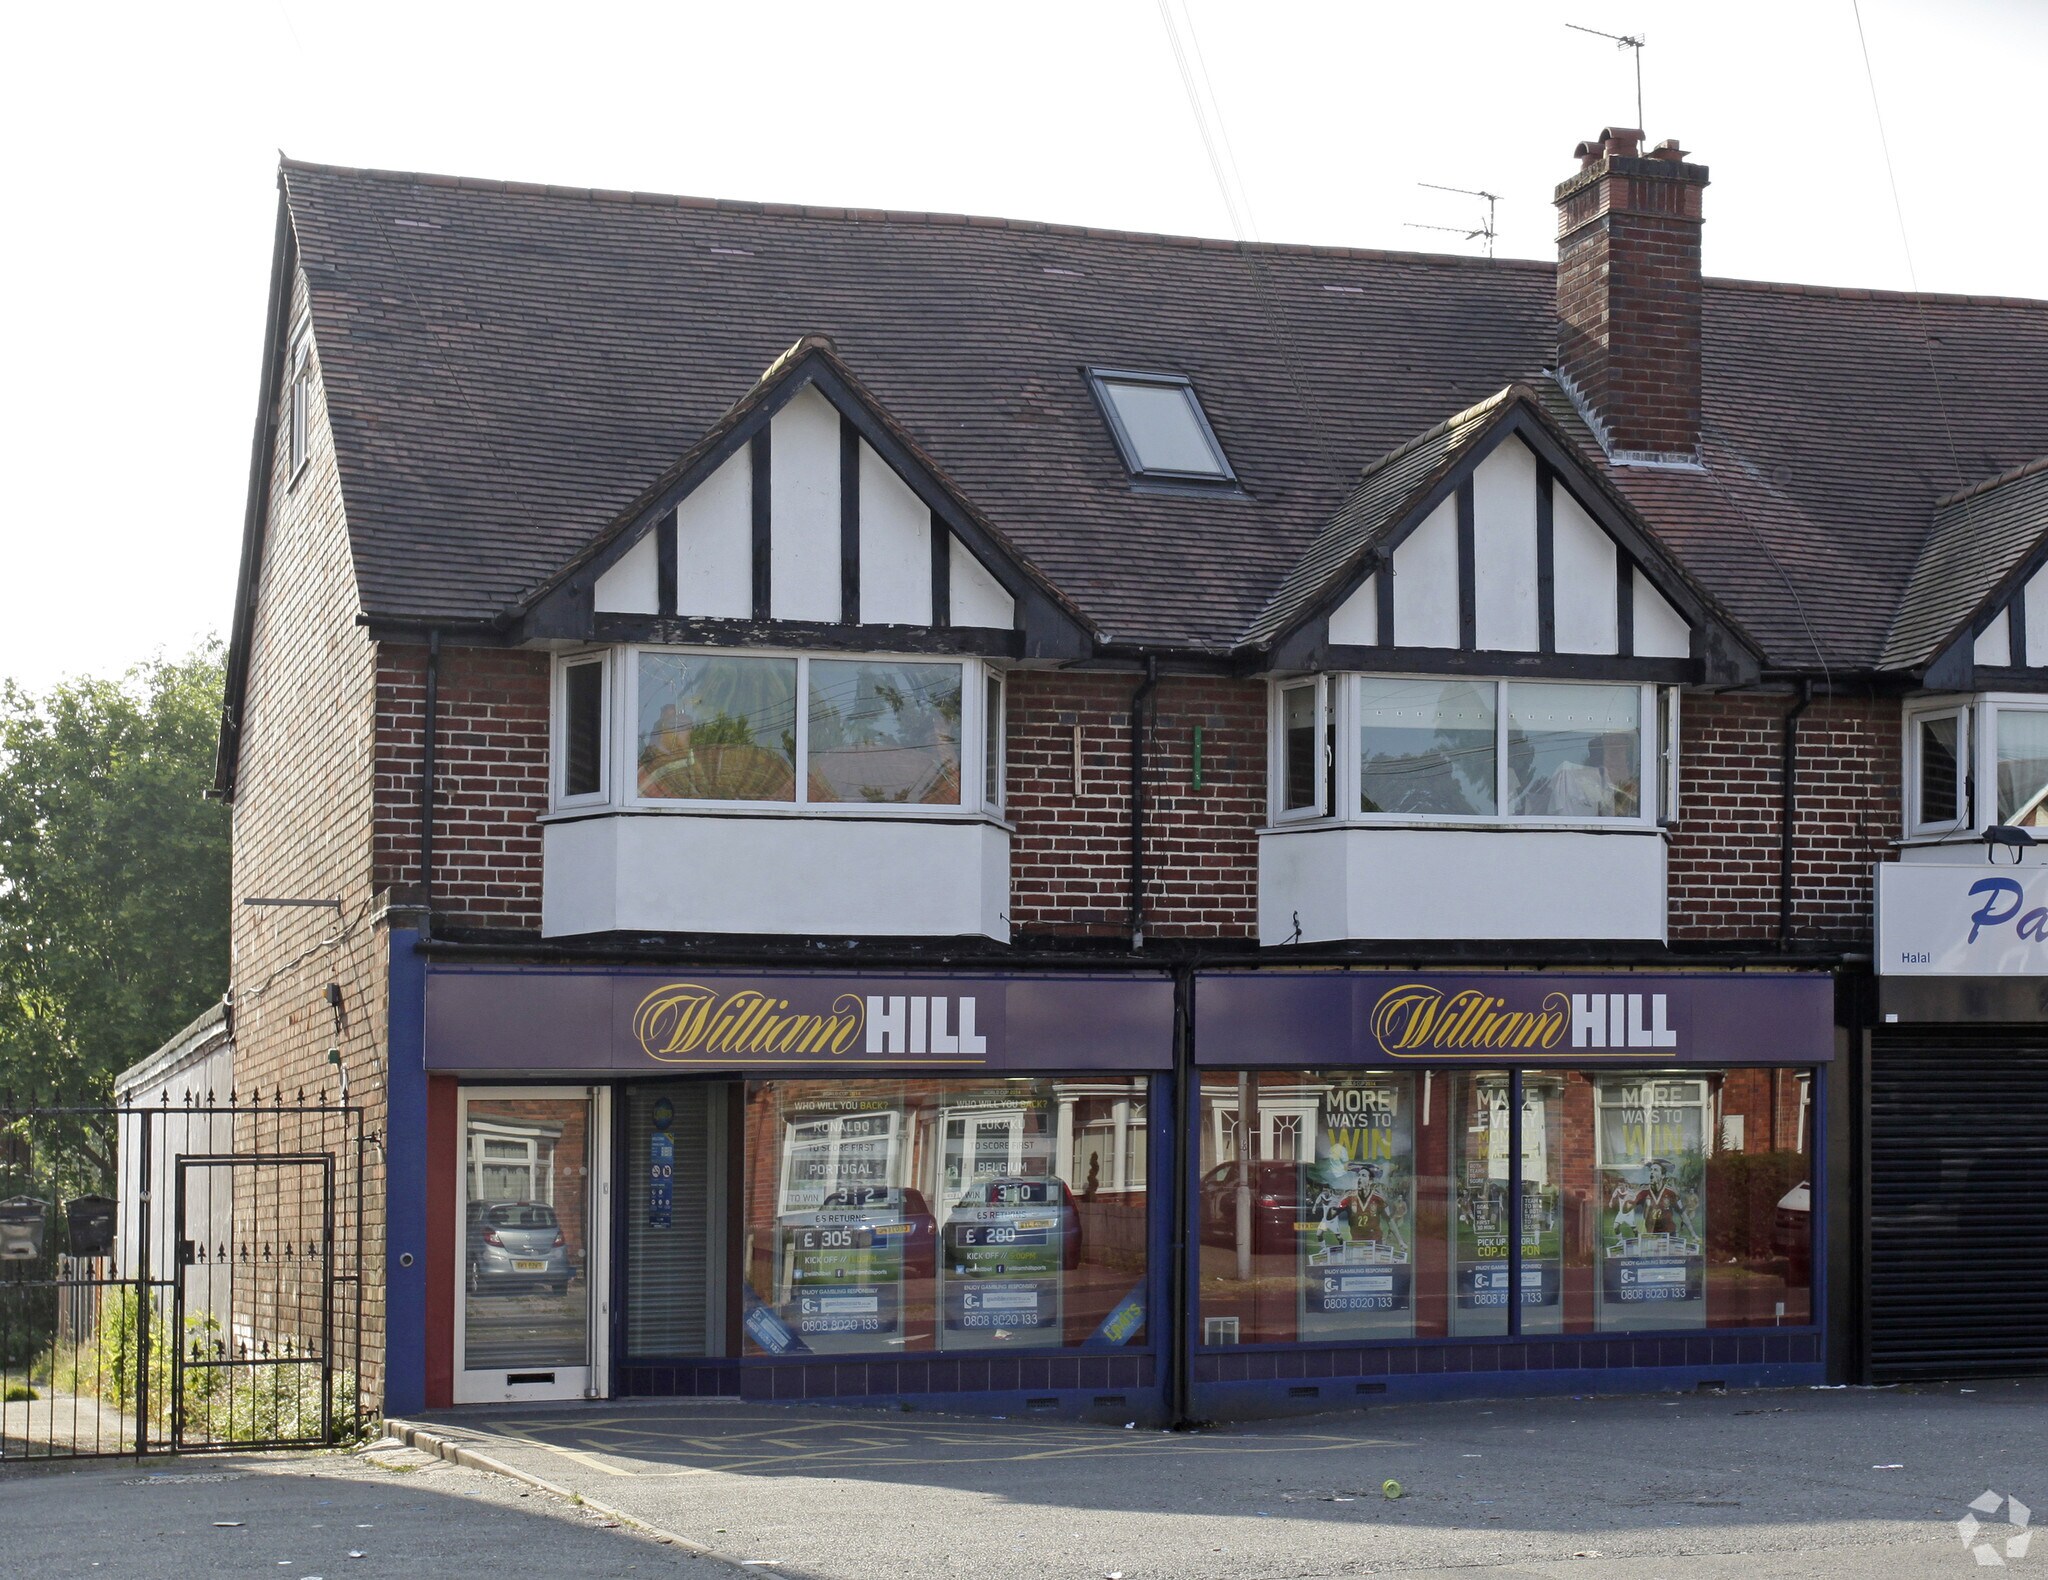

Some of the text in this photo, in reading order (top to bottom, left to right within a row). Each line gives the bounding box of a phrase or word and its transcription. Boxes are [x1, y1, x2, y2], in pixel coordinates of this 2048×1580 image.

[1901, 952, 1931, 964] Halal
[633, 983, 987, 1058] William HILL
[1370, 984, 1677, 1056] William HILL
[957, 1100, 1048, 1109] WHO WILL YOU BACK?
[1326, 1090, 1391, 1112] MORE
[1476, 1088, 1539, 1111] MAE
[1621, 1087, 1682, 1109] MORE
[794, 1101, 889, 1110] WHO WILL YOU BACK?
[1326, 1113, 1392, 1128] WAYS TO
[1621, 1109, 1682, 1123] WAYS TO
[813, 1121, 870, 1132] RONALDO
[980, 1119, 1026, 1130] LUKAKU
[1011, 1141, 1034, 1149] FIRST
[1327, 1128, 1392, 1160] WIN
[1622, 1124, 1682, 1156] WIN
[808, 1143, 874, 1152] TO SCORE FIRST
[809, 1163, 873, 1175] PORTUGAL
[978, 1162, 1027, 1172] BELGIUM
[790, 1187, 874, 1203] TO WIN 3 2
[965, 1191, 980, 1199] WIN
[828, 1214, 867, 1222] RETURNS
[989, 1210, 1026, 1219] RETURNS
[822, 1230, 851, 1247] 305
[986, 1227, 1016, 1243] 280
[1477, 1238, 1495, 1247] PICK
[1496, 1238, 1506, 1246] UP
[966, 1252, 983, 1260] KICK
[1477, 1246, 1498, 1257] CUP
[804, 1256, 822, 1264] KICK
[823, 1256, 838, 1264] OFF
[1474, 1294, 1498, 1305] 0808
[1526, 1292, 1542, 1303] 133
[1620, 1287, 1687, 1300] 0808 8020 133
[1323, 1296, 1393, 1310] 0808 8020 133
[801, 1318, 879, 1332] 0808 8020 133
[963, 1313, 1038, 1327] 0808 8020 133
